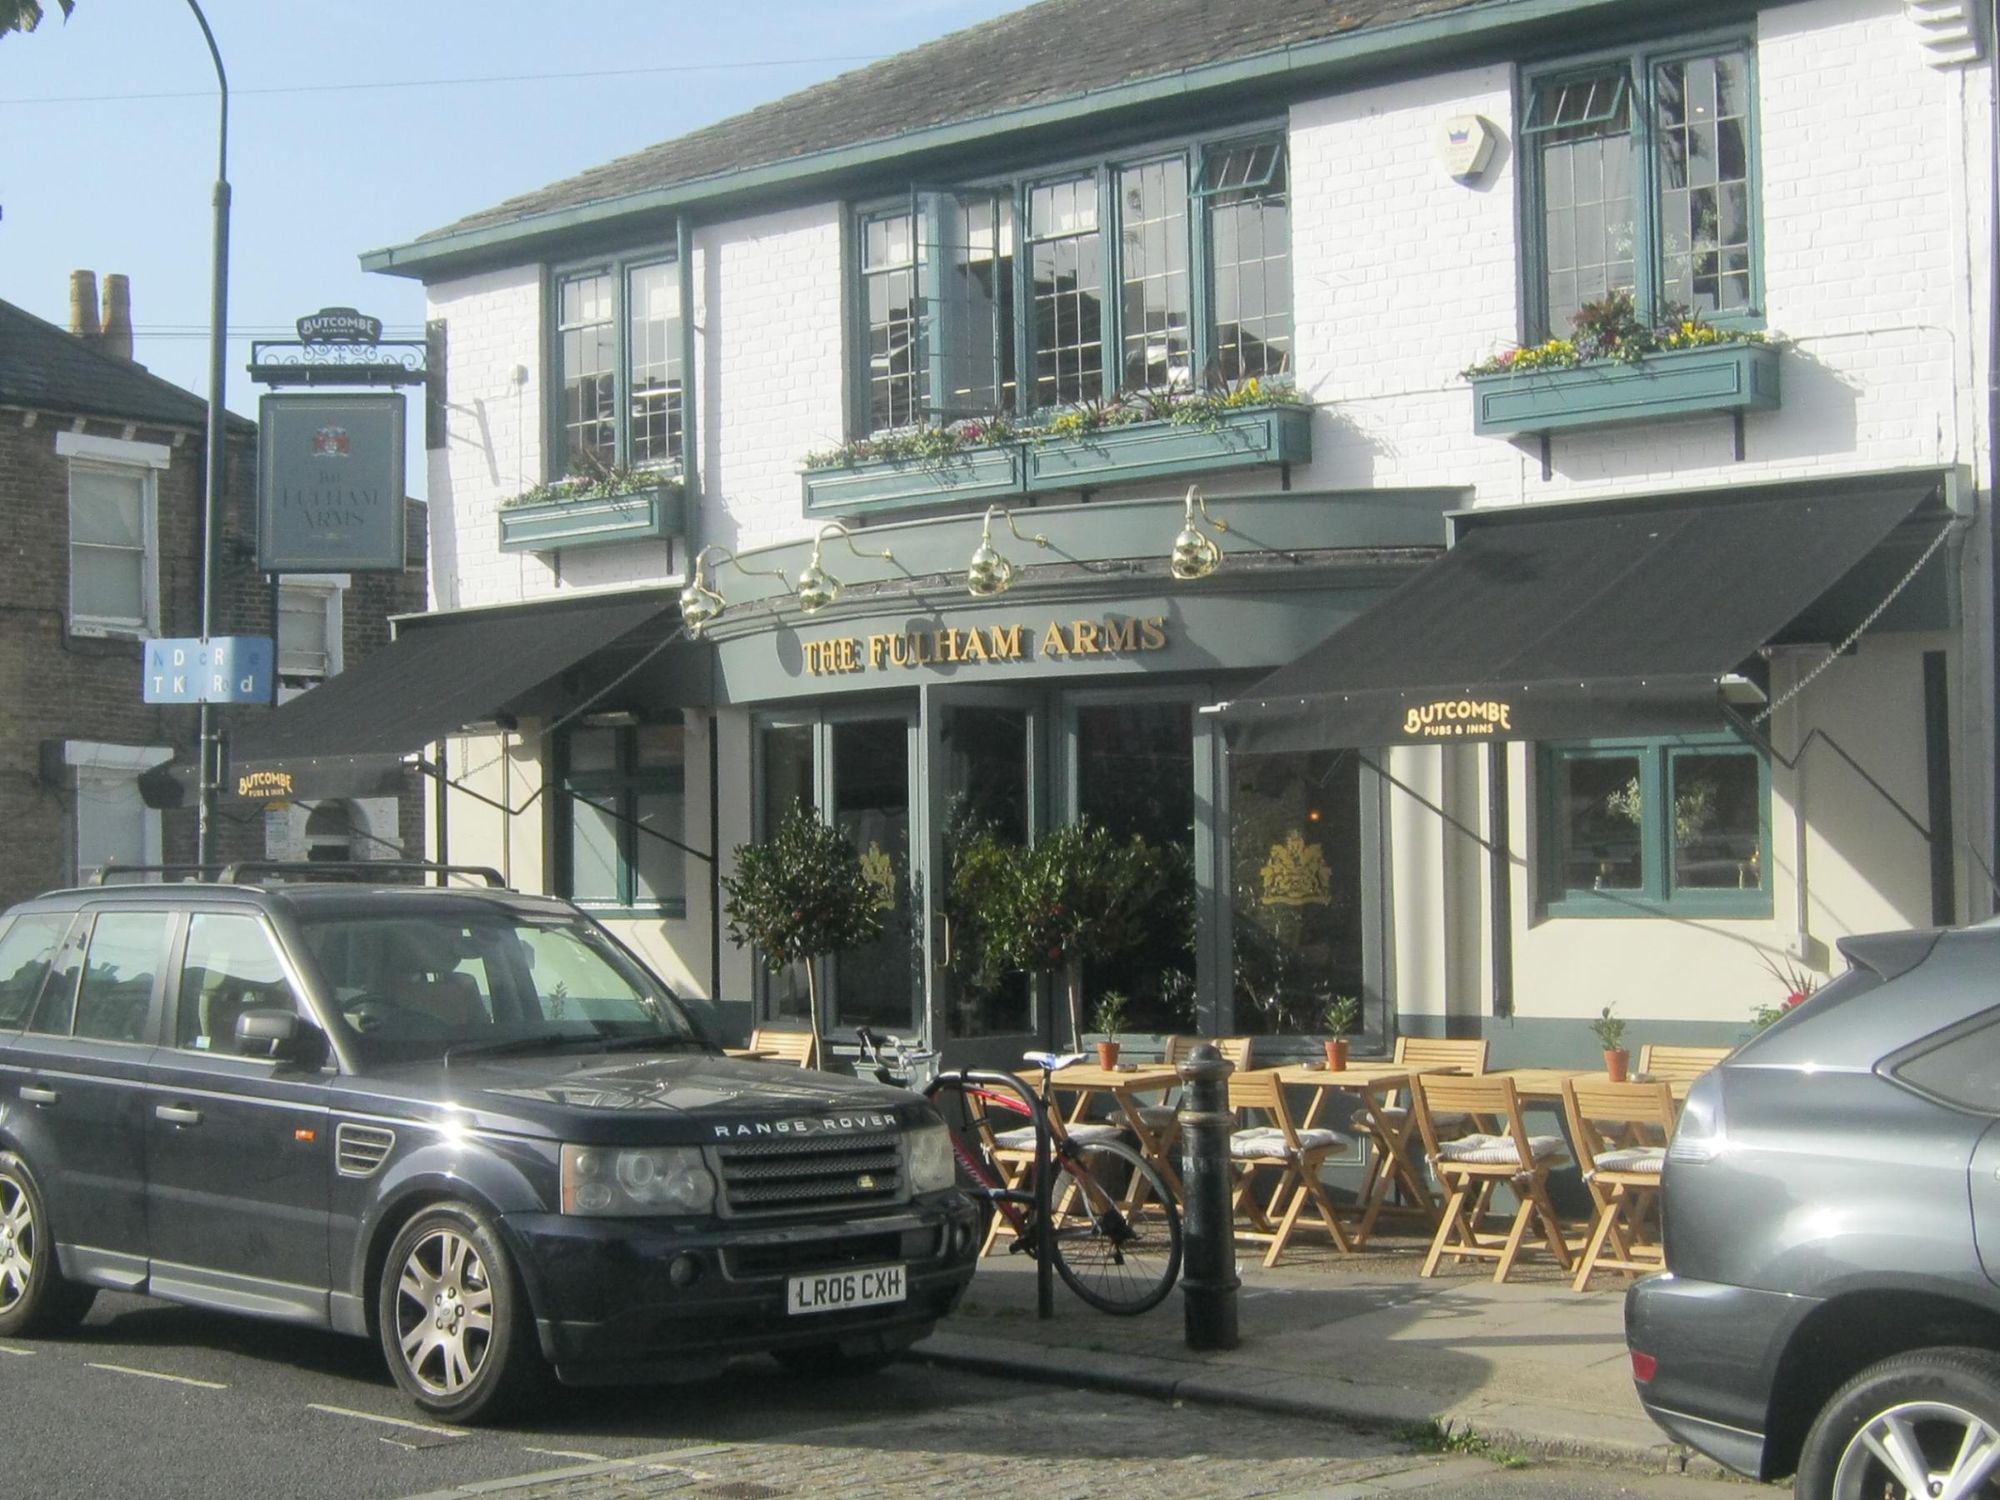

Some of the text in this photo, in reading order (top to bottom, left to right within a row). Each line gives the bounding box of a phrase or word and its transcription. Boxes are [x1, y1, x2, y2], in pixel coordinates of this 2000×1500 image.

[301, 317, 374, 335] BUTCOMBE
[803, 616, 1167, 672] THE FULHAM ARMS
[1404, 701, 1511, 734] BUTCOMBE
[1425, 723, 1494, 736] PUBS & INNS
[238, 772, 293, 795] BUTCOMBE
[714, 1114, 896, 1137] RANGE ROVER
[799, 1269, 900, 1307] LR06 CXH
